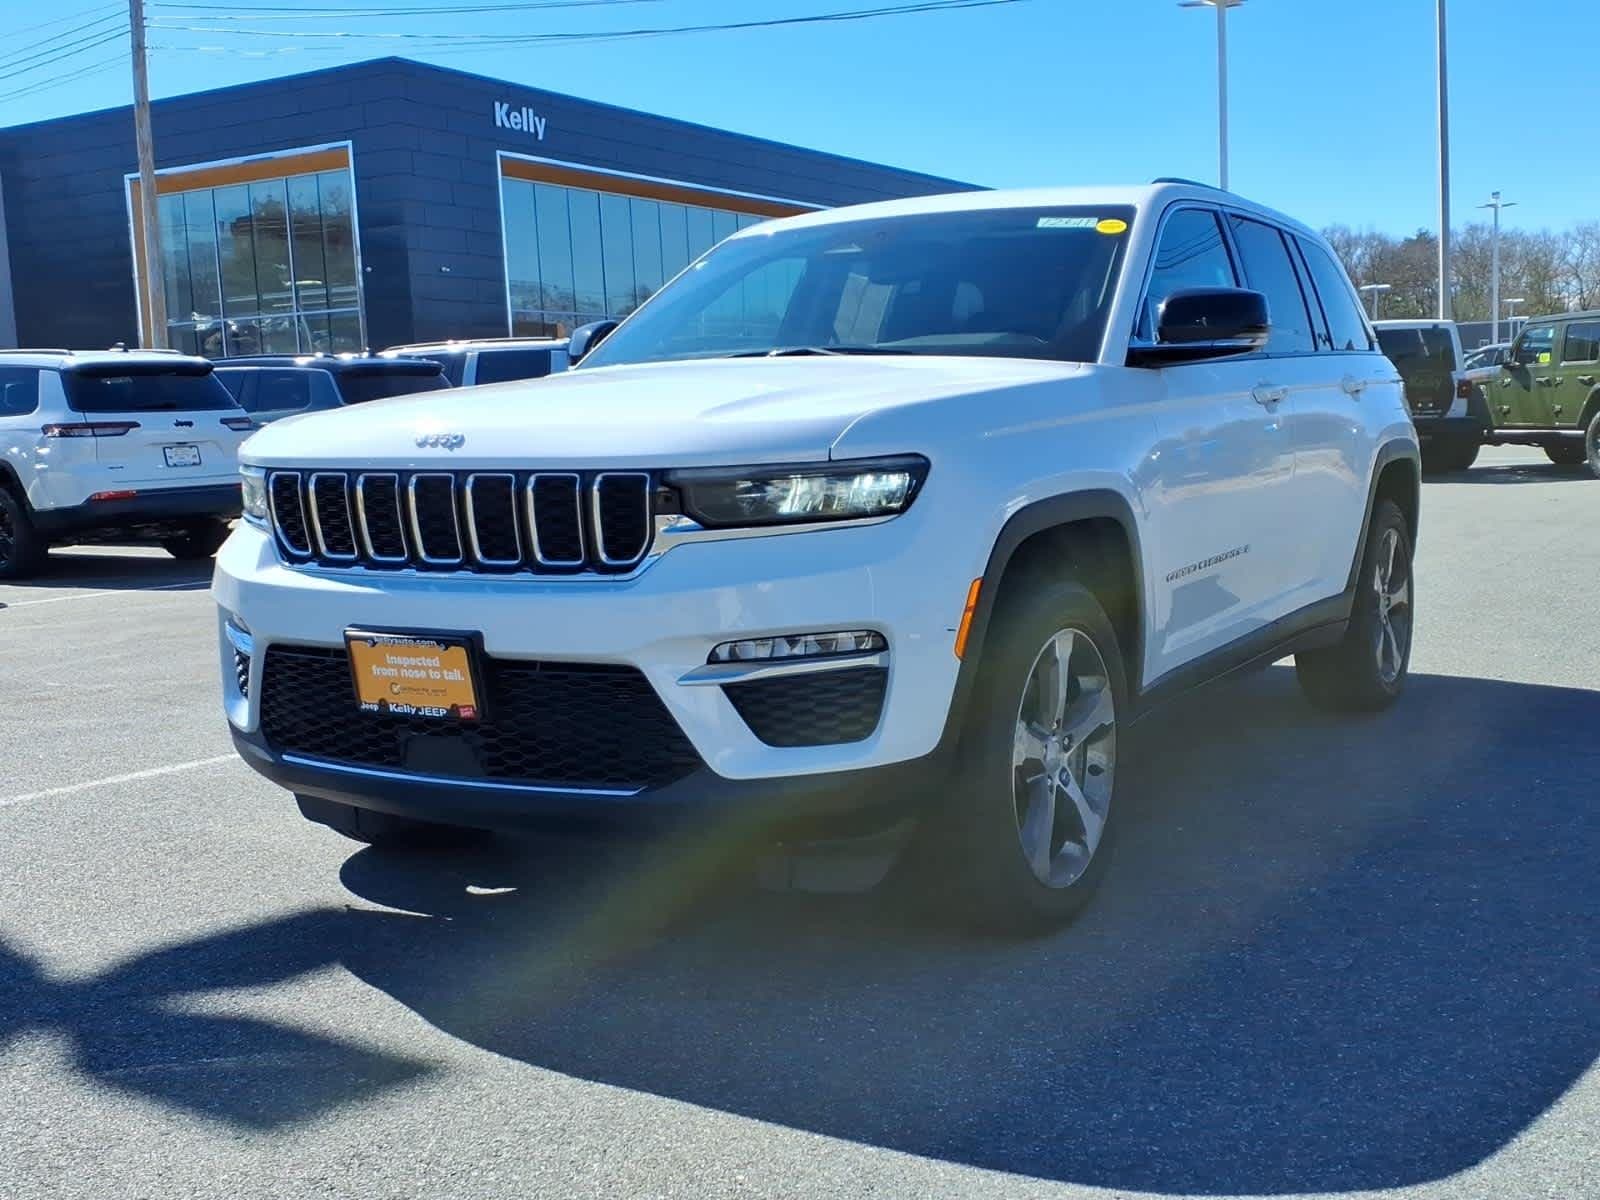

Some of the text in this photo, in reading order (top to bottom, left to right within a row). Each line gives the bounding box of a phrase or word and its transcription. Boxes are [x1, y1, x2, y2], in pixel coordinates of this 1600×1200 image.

[494, 101, 546, 141] Kelly
[415, 433, 465, 452] Jeep
[386, 654, 440, 668] Inspected
[372, 665, 465, 681] from nose to tail.
[360, 702, 380, 713] Jeep
[388, 703, 417, 716] Kelly
[418, 707, 448, 718] JEEP
